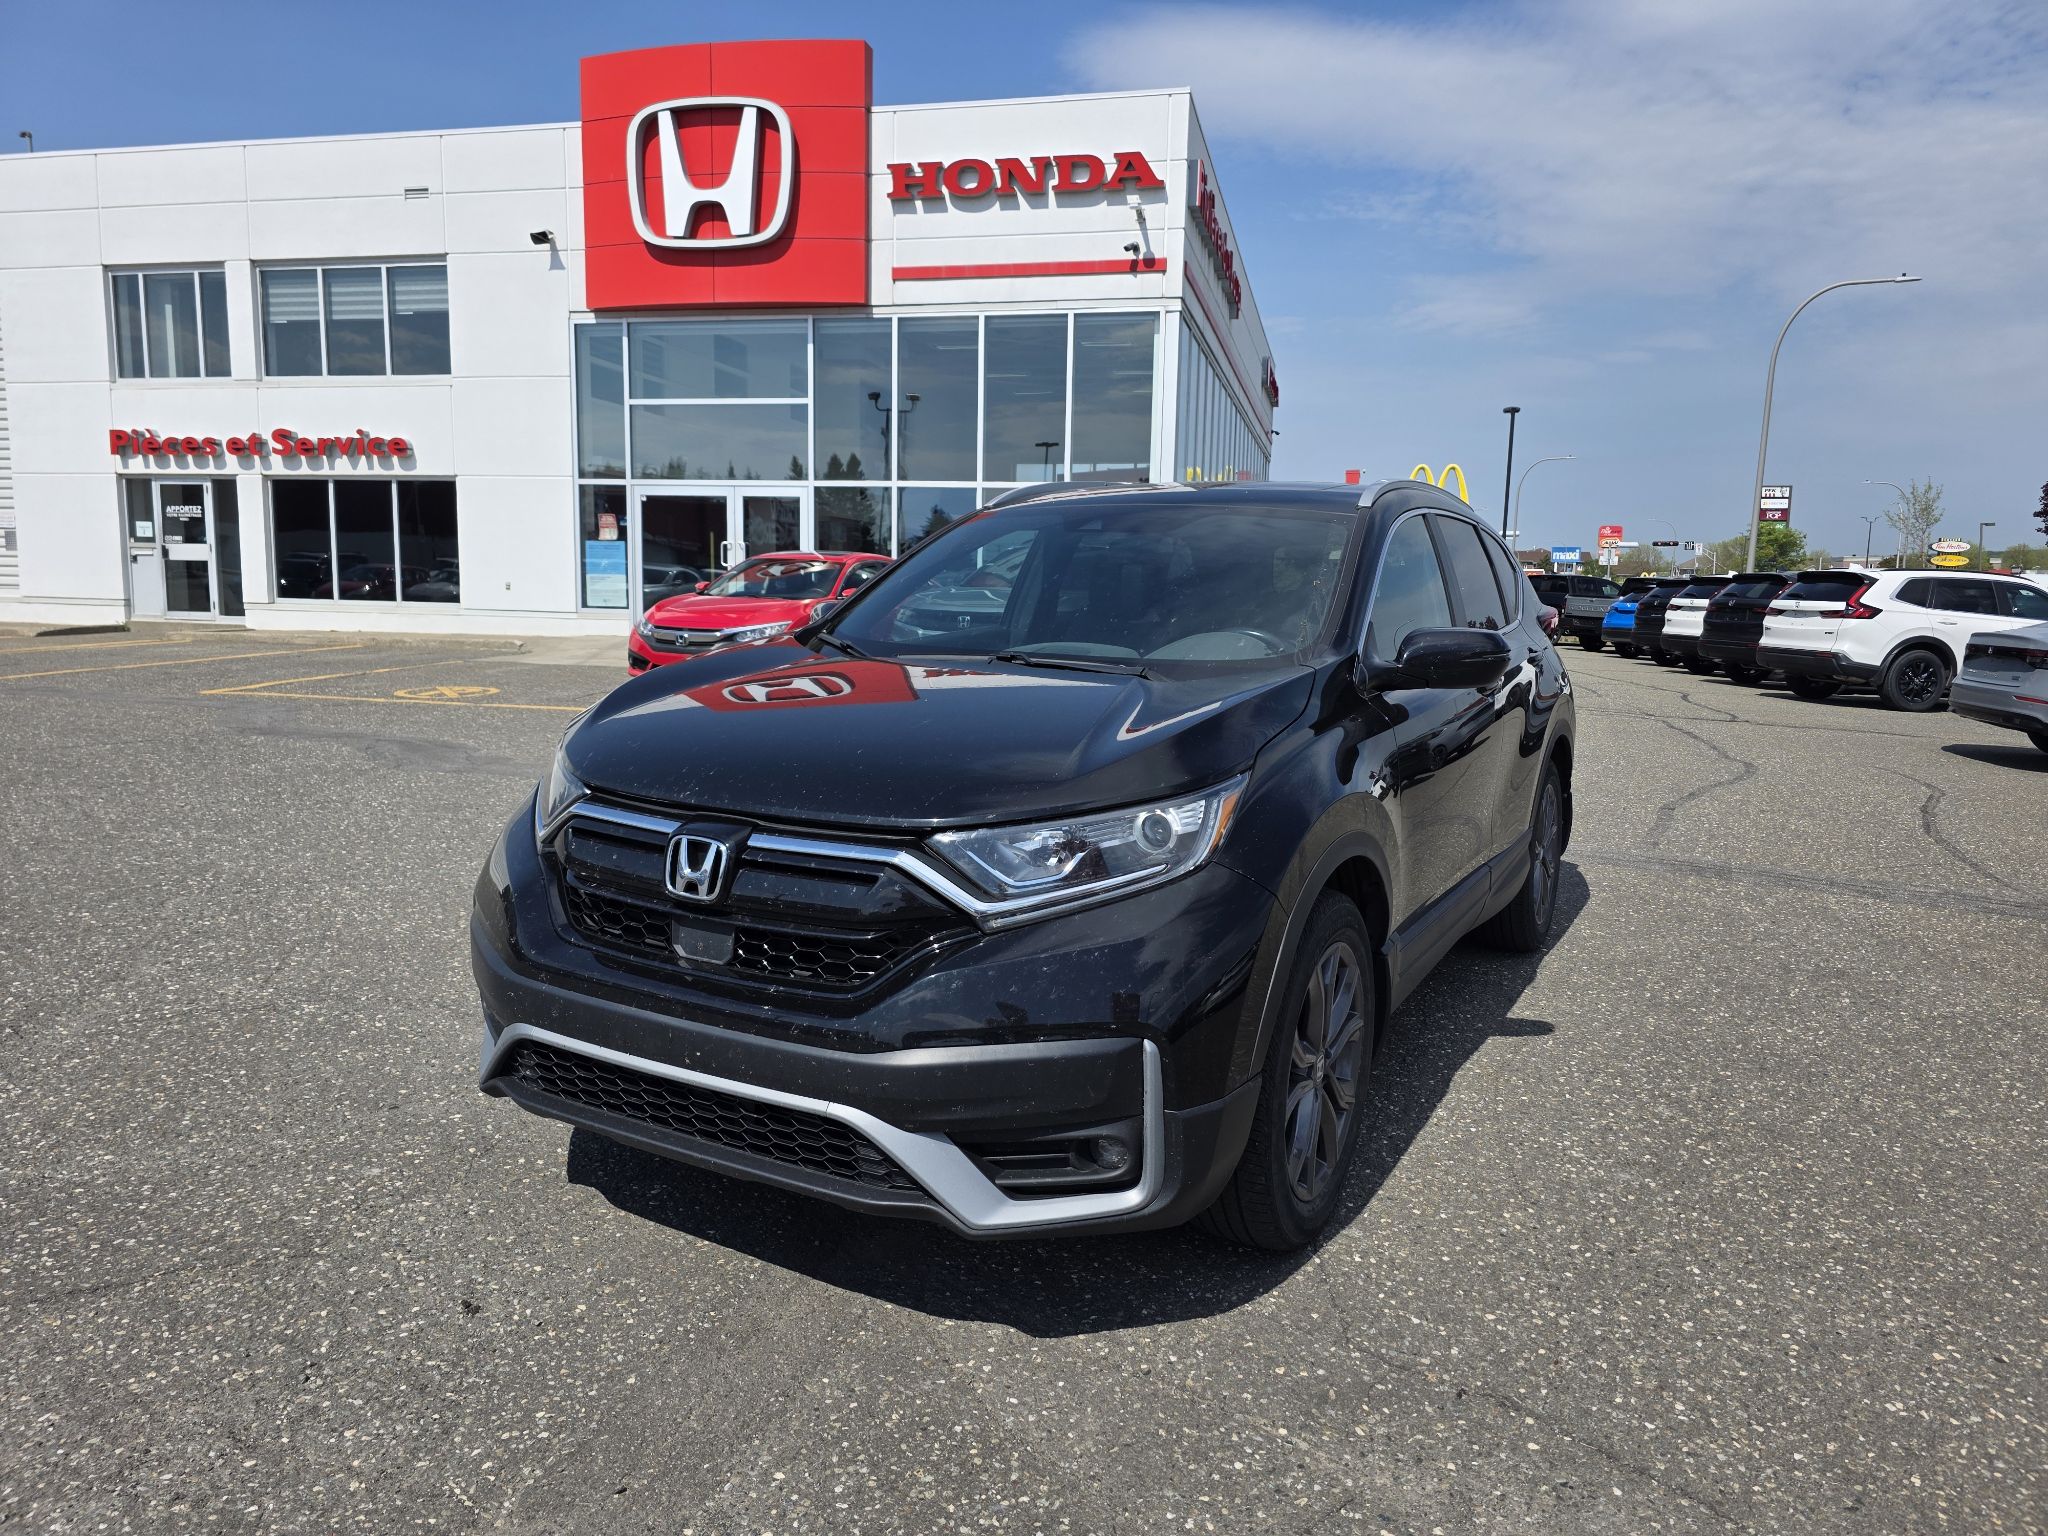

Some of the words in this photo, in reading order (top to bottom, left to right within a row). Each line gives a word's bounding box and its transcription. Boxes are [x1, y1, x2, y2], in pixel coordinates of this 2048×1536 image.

[887, 151, 1165, 199] HONDA
[109, 429, 217, 457] Pièces
[226, 433, 263, 456] et
[271, 428, 410, 457] Service
[1552, 549, 1579, 560] maxi
